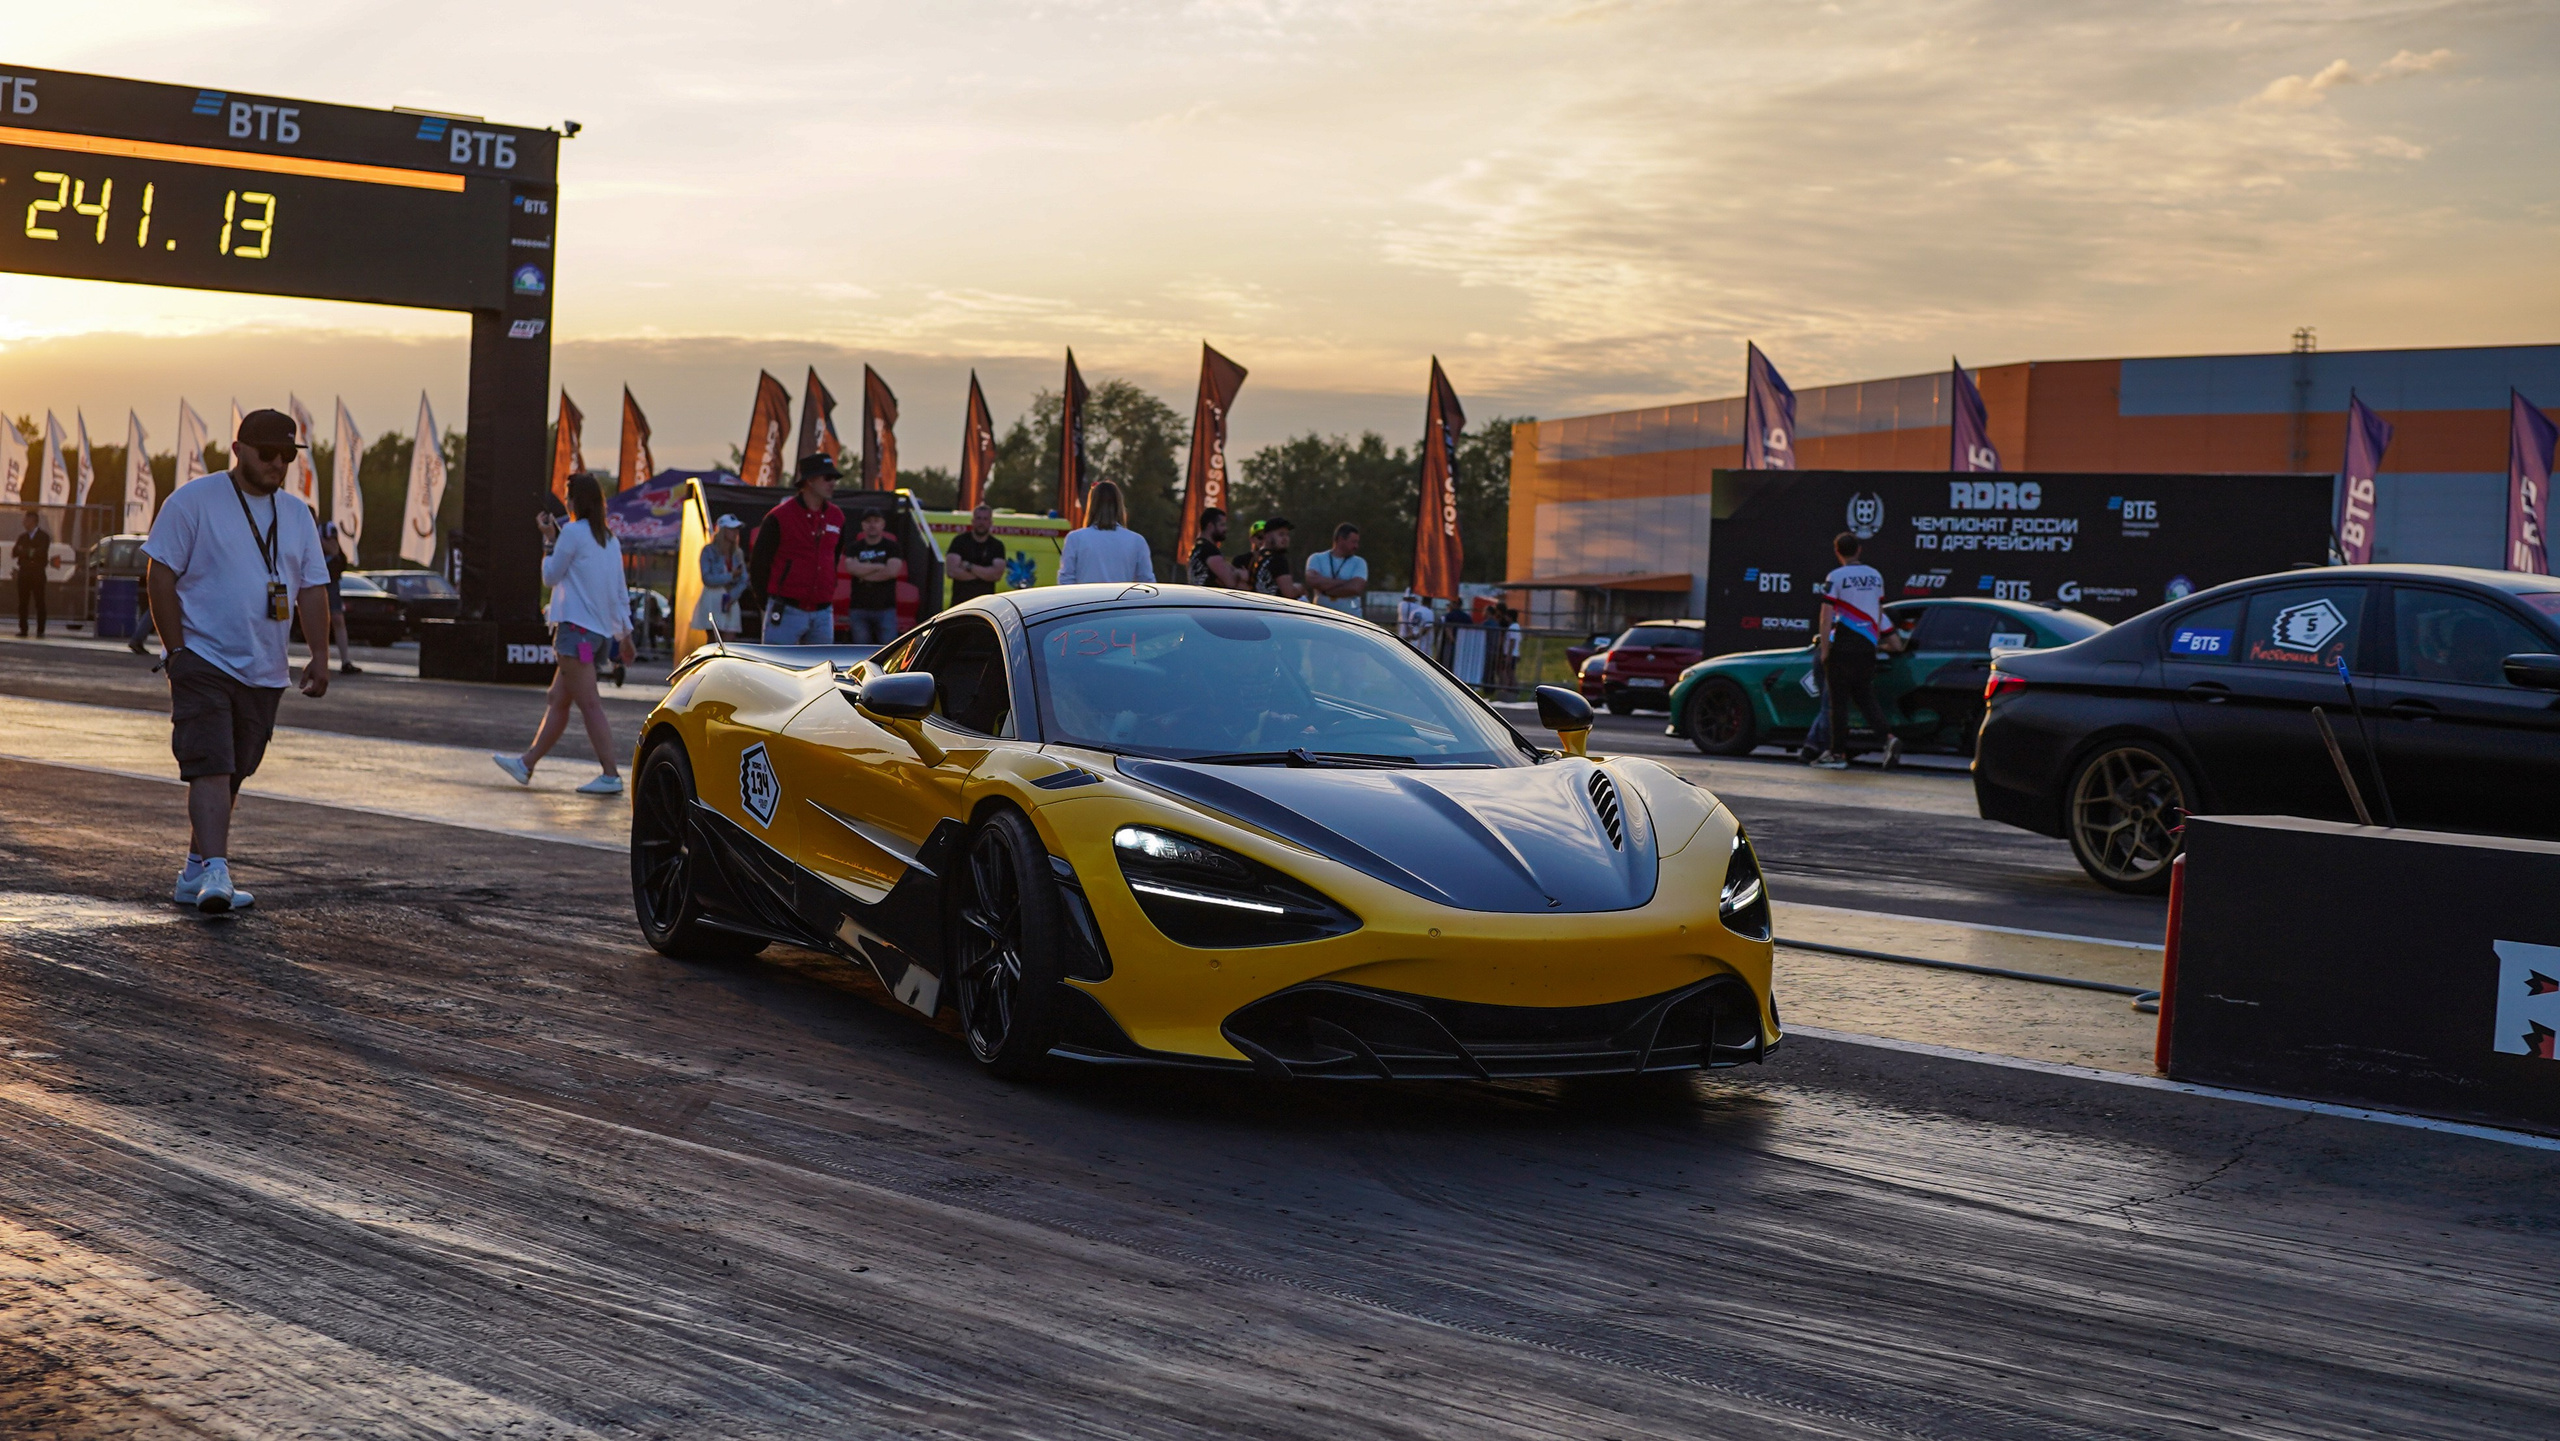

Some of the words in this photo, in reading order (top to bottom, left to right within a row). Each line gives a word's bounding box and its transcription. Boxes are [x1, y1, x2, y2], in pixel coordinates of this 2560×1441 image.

[0, 75, 38, 114] ТБ
[228, 102, 300, 144] ВТБ
[450, 128, 517, 169] ВТБ
[523, 199, 548, 215] ВТБ
[1950, 482, 2041, 511] RDRC
[2122, 500, 2157, 520] ВТБ
[2341, 476, 2375, 548] ВТБ
[1912, 517, 2007, 533] ЧЕМПИОНАТ
[2012, 518, 2078, 534] РОССИИ
[1915, 534, 1938, 549] ПО
[1941, 531, 2073, 551] ДРЭГ-РЕЙСИНГУ
[1758, 572, 1791, 593] ВТБ
[1905, 574, 1947, 589] АВТО
[1994, 580, 2031, 600] ВТБ
[2306, 617, 2318, 632] 5
[1053, 629, 1136, 657] 134
[2190, 636, 2220, 651] ВТБ
[507, 644, 557, 664] RDR
[751, 770, 770, 798] 134
